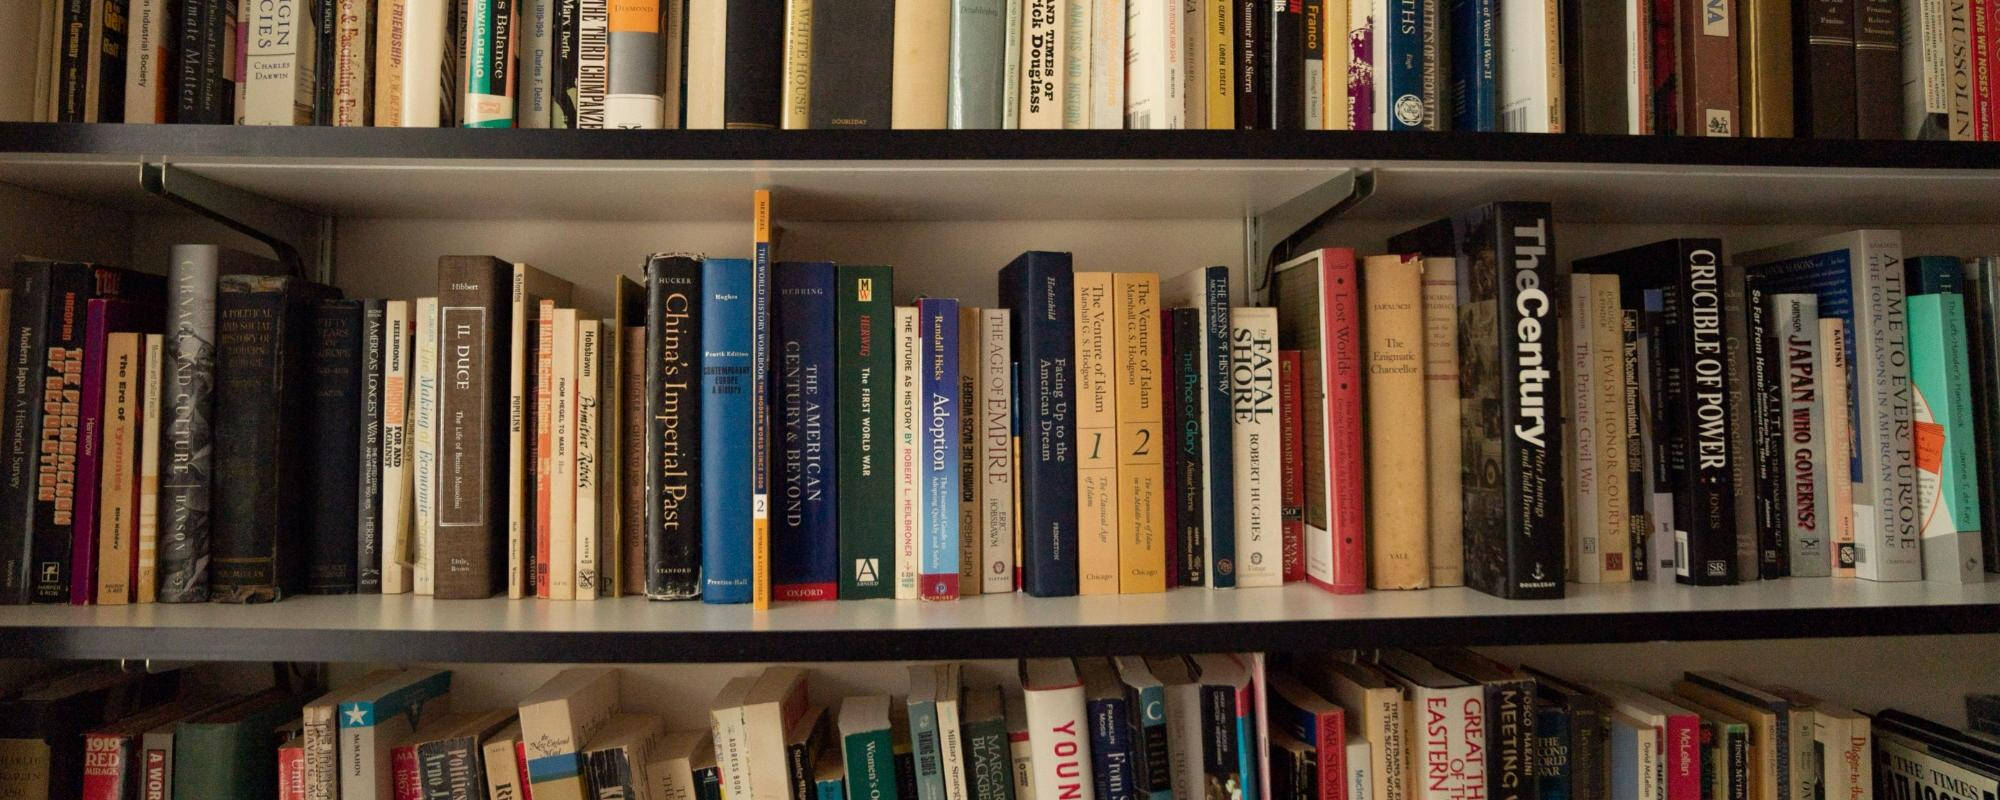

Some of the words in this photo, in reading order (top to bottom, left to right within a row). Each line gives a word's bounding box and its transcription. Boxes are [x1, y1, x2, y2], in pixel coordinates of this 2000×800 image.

[1245, 2, 1254, 37] Summer
[1308, 5, 1318, 49] Franco
[1483, 8, 1491, 16] of
[1976, 8, 1986, 34] HAVE
[141, 10, 150, 51] Industrial
[391, 4, 403, 68] FRIENDSHIP:
[494, 15, 508, 79] Balance
[561, 31, 570, 59] Derfler
[798, 10, 809, 58] WHITE
[1484, 20, 1492, 46] World
[1978, 36, 1986, 56] WET
[138, 54, 148, 87] Society
[1045, 30, 1054, 76] TIMES
[1484, 49, 1492, 67] War
[183, 49, 197, 111] Matters
[794, 63, 806, 115] HOUSE
[1029, 35, 1043, 114] Douglass
[1044, 83, 1053, 101] OF
[1245, 66, 1254, 92] Sierra
[1485, 70, 1491, 80] II
[1979, 58, 1988, 97] NOSES?
[1884, 254, 1899, 268] A
[757, 266, 765, 296] WORLD
[1093, 284, 1103, 311] The
[178, 260, 195, 348] CARNAGE
[757, 298, 765, 331] HISTORY
[1335, 293, 1348, 326] Lost
[1690, 250, 1721, 354] CRUCIBLE
[1886, 272, 1901, 332] TIME
[457, 324, 470, 337] IL
[664, 293, 688, 374] China's
[904, 316, 912, 333] THE
[934, 315, 943, 352] Randall
[989, 313, 1004, 341] THE
[1094, 313, 1104, 359] Venture
[18, 326, 31, 364] Modern
[48, 347, 66, 372] OF
[367, 320, 379, 370] AMERICA'S
[392, 320, 400, 372] HEILBRONER
[583, 330, 594, 377] Hobsbawm
[904, 337, 912, 371] FUTURE
[989, 343, 1004, 374] AGE
[1336, 326, 1349, 376] Worlds
[1577, 343, 1589, 368] The
[1888, 336, 1903, 367] TO
[15, 367, 29, 394] Japan
[64, 348, 82, 384] THE
[176, 350, 194, 386] AND
[456, 346, 470, 389] DUCE
[805, 364, 818, 394] THE
[862, 368, 870, 383] The
[904, 375, 912, 387] AS
[934, 354, 944, 380] Hicks
[1053, 358, 1065, 398] Facing
[1094, 362, 1105, 375] of
[1234, 328, 1253, 425] SHORE
[1254, 338, 1273, 425] FATAL
[1515, 289, 1549, 447] Century
[1602, 347, 1617, 404] JEWISH
[1695, 359, 1721, 391] OF
[1790, 334, 1815, 404] JAPAN
[367, 374, 379, 418] LONGEST
[558, 377, 566, 397] FROM
[785, 341, 800, 429] CENTURY
[862, 388, 870, 413] FIRST
[990, 377, 1005, 395] OF
[1040, 358, 1052, 415] American
[1095, 378, 1106, 413] Islam
[1578, 374, 1590, 422] Private
[17, 400, 28, 408] A
[455, 411, 464, 424] The
[512, 395, 521, 432] POPULISM
[558, 399, 566, 423] HEGEL
[904, 390, 913, 430] HISTORY
[1054, 402, 1066, 421] Up
[1892, 375, 1908, 439] EVERY
[13, 409, 27, 453] Historical
[38, 378, 63, 501] REVOLUTION
[84, 417, 95, 456] Hamerow
[173, 393, 190, 474] CULTURE
[366, 420, 377, 443] WAR
[384, 426, 393, 468] AGAINST
[393, 426, 402, 445] FOR
[455, 426, 463, 440] Life
[455, 442, 463, 450] of
[558, 426, 565, 434] TO
[656, 383, 687, 477] Imperial
[786, 432, 796, 441] &
[862, 418, 870, 451] WORLD
[904, 433, 912, 445] BY
[929, 393, 949, 471] Adoption
[988, 398, 1007, 484] EMPIRE
[1041, 420, 1053, 462] Dream
[1056, 426, 1066, 438] to
[1579, 427, 1591, 462] Civil
[1605, 410, 1618, 471] HONOR
[1697, 393, 1725, 469] POWER
[1794, 408, 1811, 451] WHO
[54, 389, 80, 525] PHENOMENON
[393, 448, 401, 468] AND
[454, 452, 462, 472] Benito
[805, 400, 822, 502] AMERICAN
[862, 456, 870, 477] WAR
[904, 448, 912, 484] ROBERT
[1056, 441, 1067, 462] the
[1250, 433, 1260, 484] ROBERT
[10, 456, 24, 489] Survey
[786, 450, 800, 527] BEYOND
[1579, 468, 1592, 495] War
[454, 476, 462, 509] Mussolini
[664, 484, 687, 530] Past
[904, 488, 912, 496] L.
[1607, 475, 1621, 535] COURTS
[1799, 451, 1816, 531] GOVERNS?
[1896, 450, 1916, 549] PURPOSE
[174, 495, 188, 552] HANSON
[904, 500, 912, 557] HEILBRONER
[990, 498, 1000, 547] HOBSBAWM
[999, 511, 1007, 532] ERIC
[1251, 488, 1262, 541] HUGHES
[365, 516, 374, 554] HERRING
[918, 731, 933, 754] TAKING
[946, 729, 956, 763] Military
[1392, 725, 1400, 775] PARTISANS
[1428, 697, 1448, 791] EASTERN
[1464, 699, 1483, 766] GREAT
[1502, 691, 1517, 788] MEETING
[85, 752, 119, 766] RED
[730, 738, 739, 772] ADDRESS
[867, 741, 877, 788] Women's
[921, 756, 936, 776] SIDES
[1681, 728, 1691, 776] McLellan
[1734, 740, 1742, 767] HINDU
[292, 759, 303, 793] Until
[733, 776, 741, 795] BOOK
[1394, 778, 1400, 791] OF
[1735, 769, 1743, 799] MYTHS
